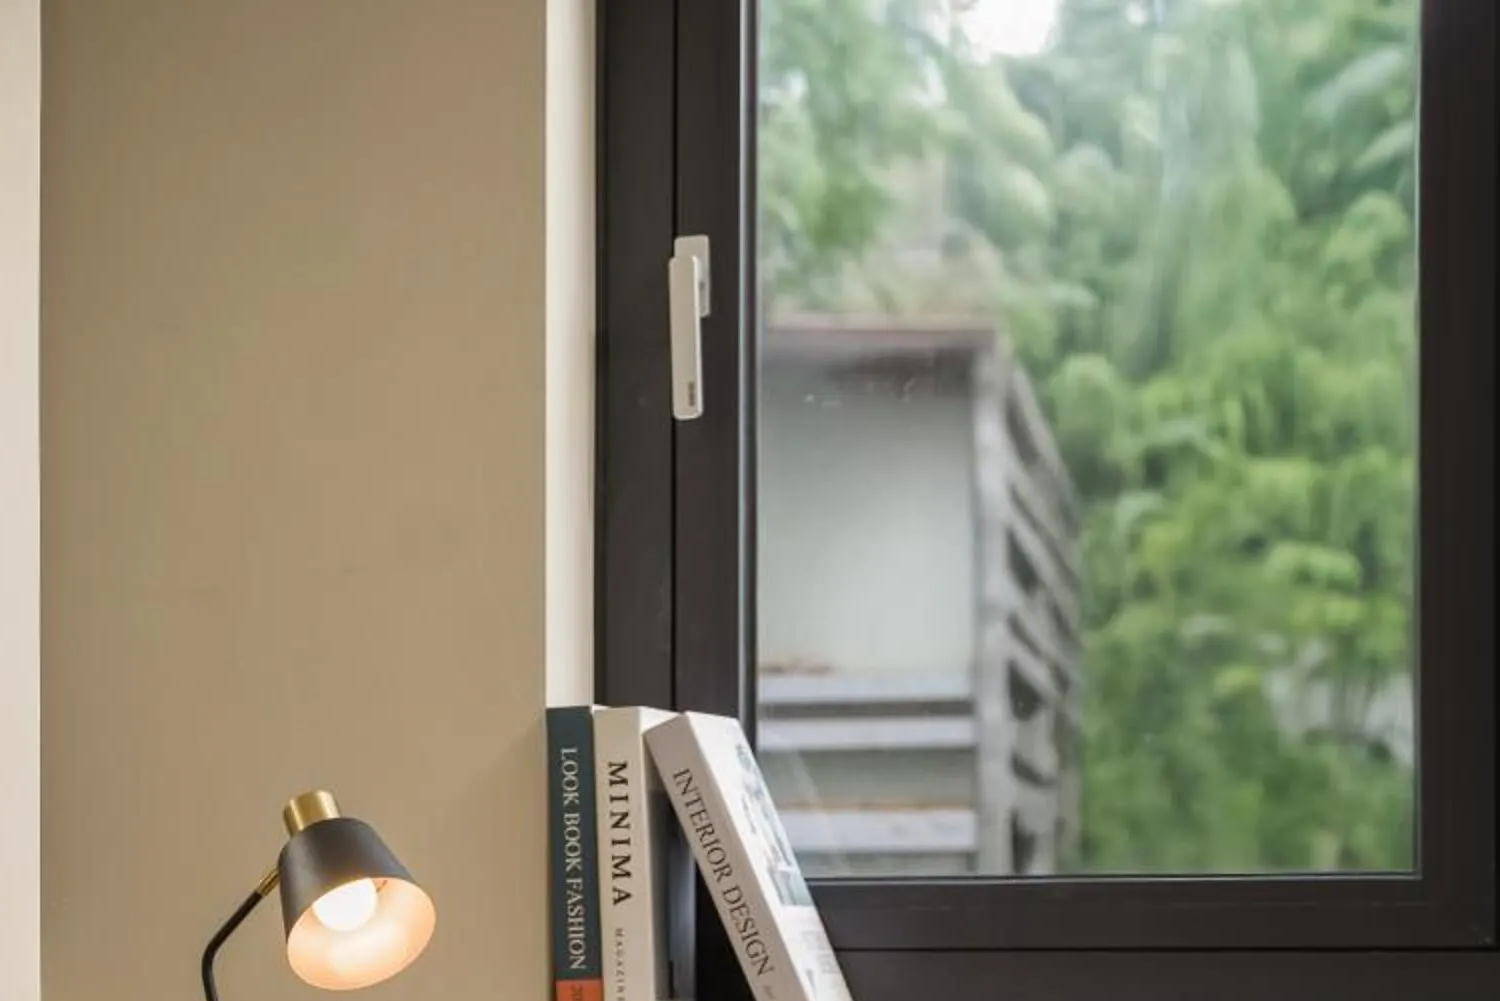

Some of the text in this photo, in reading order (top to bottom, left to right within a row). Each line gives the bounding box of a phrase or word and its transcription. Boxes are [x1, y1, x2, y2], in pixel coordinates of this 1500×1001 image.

[560, 748, 587, 970] LOOK BOOK FASHION
[608, 761, 632, 905] MINIMA
[673, 768, 775, 977] INTERIOR DESIGN
